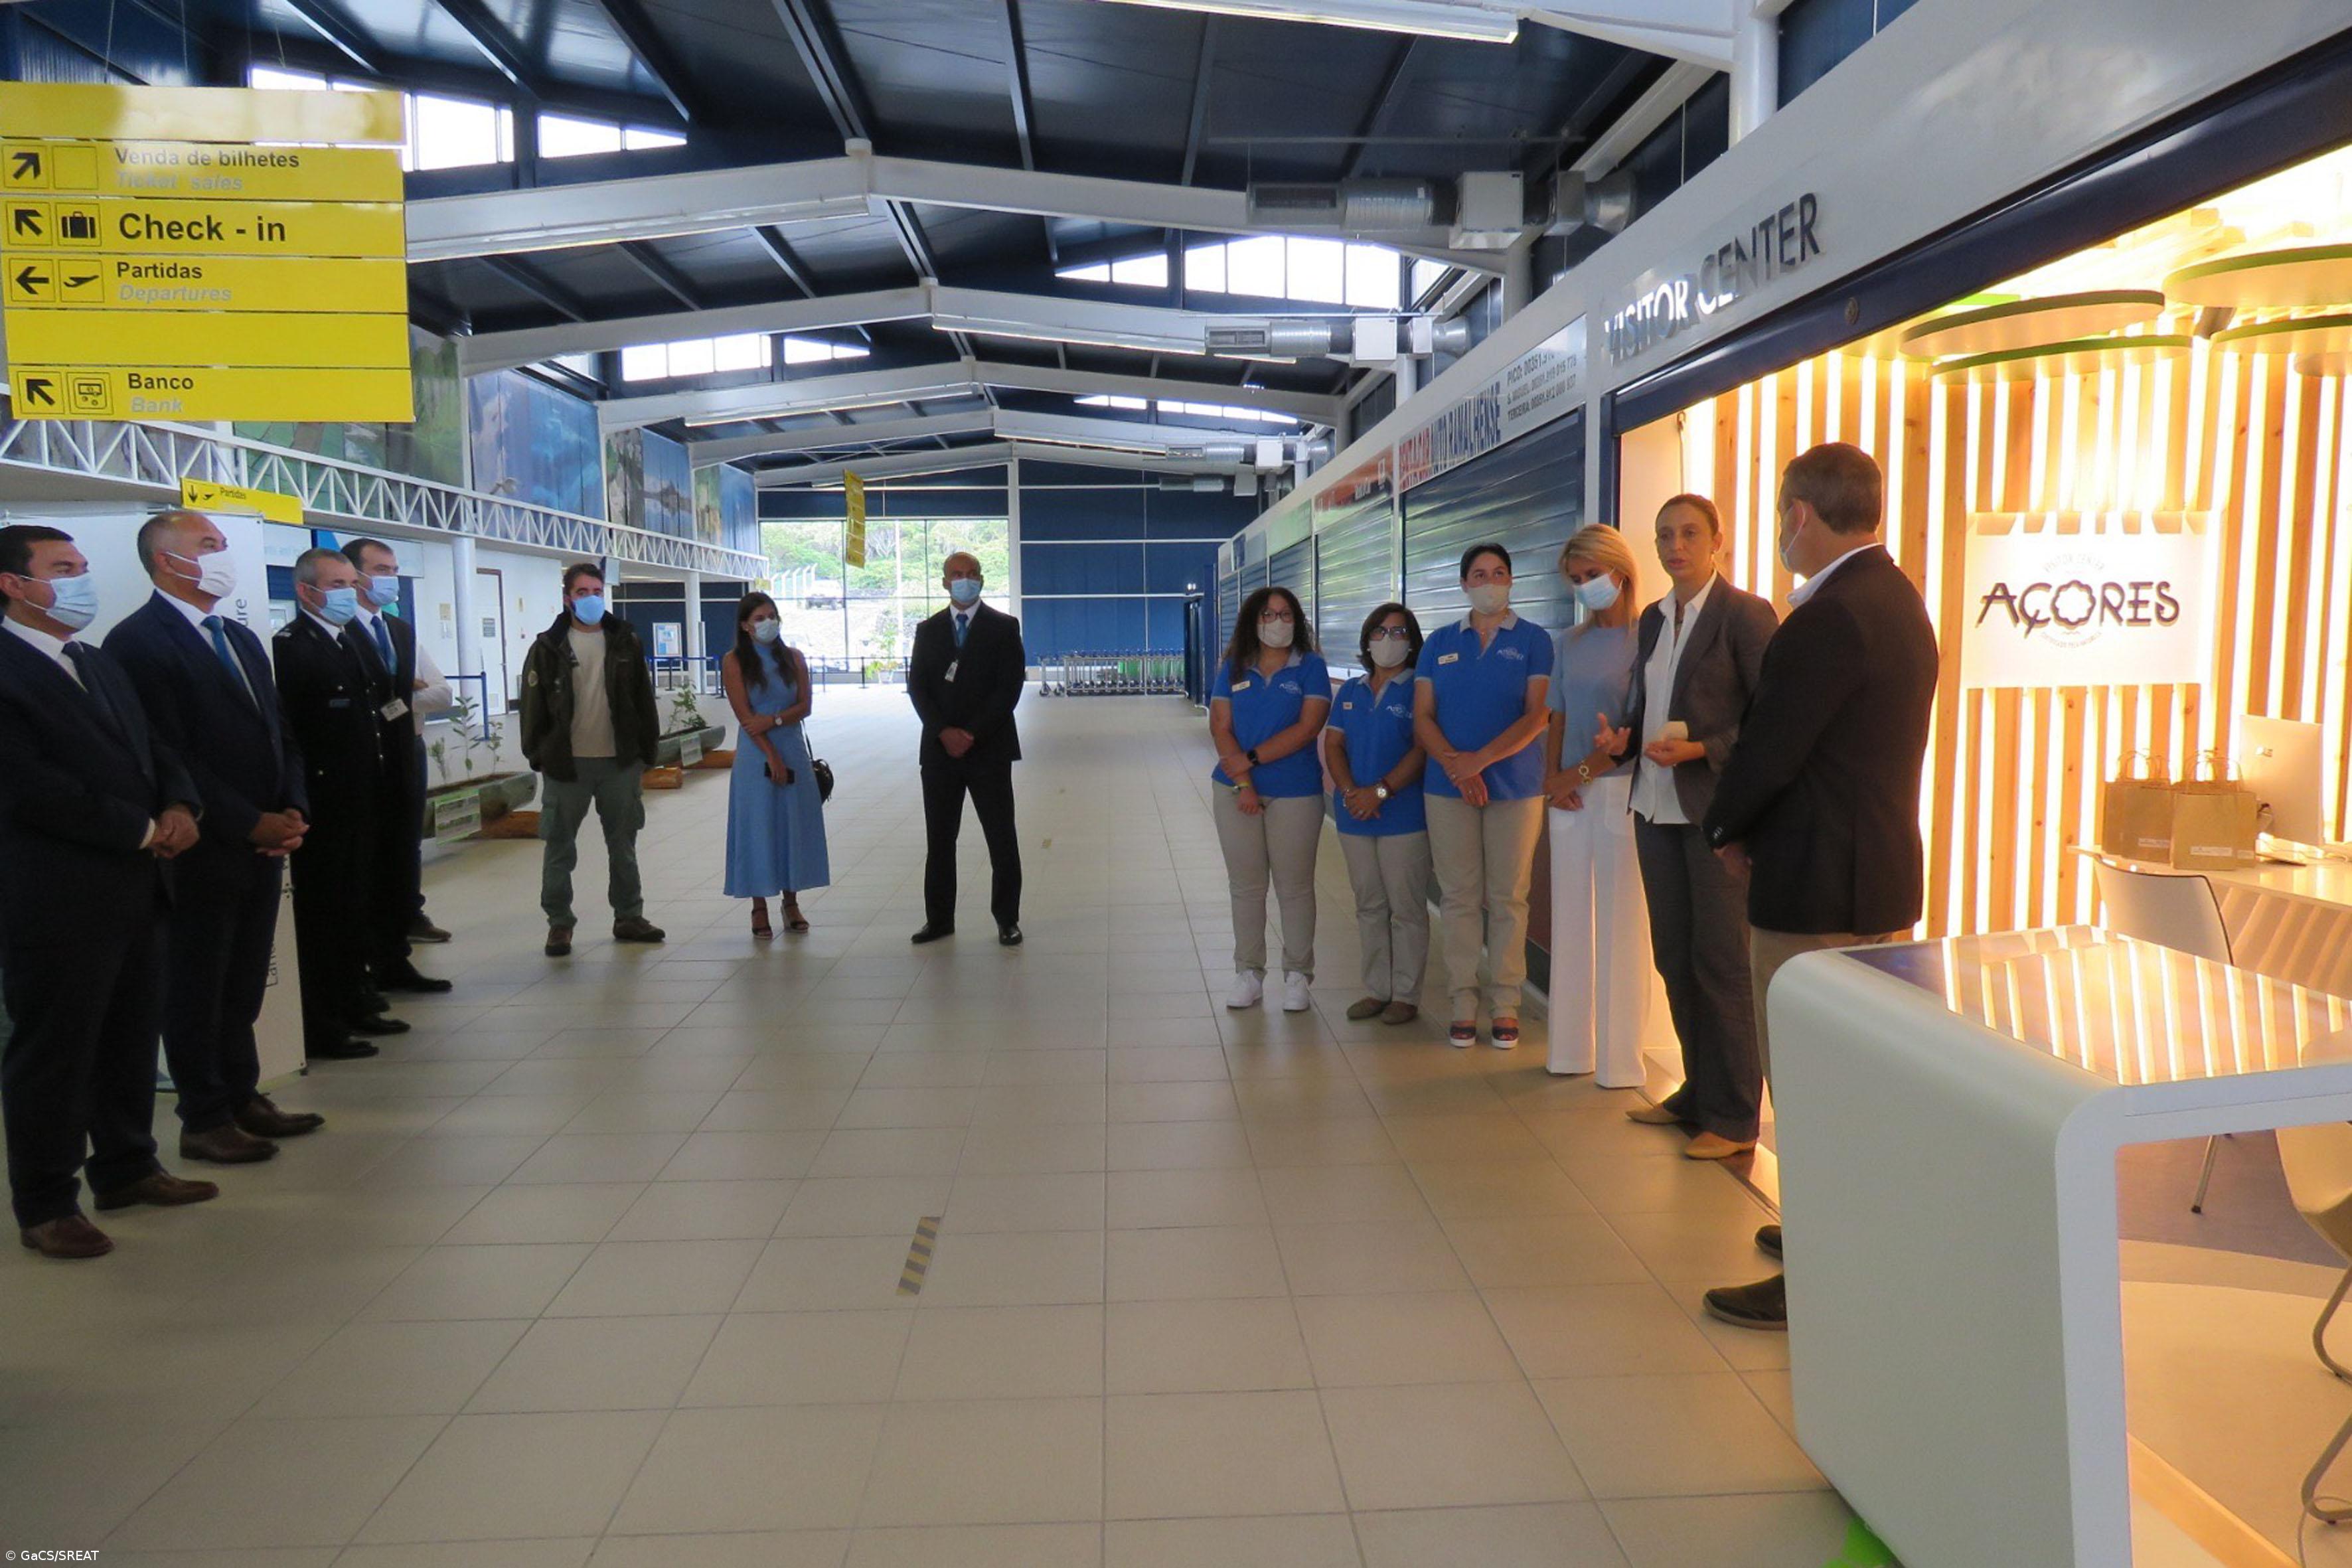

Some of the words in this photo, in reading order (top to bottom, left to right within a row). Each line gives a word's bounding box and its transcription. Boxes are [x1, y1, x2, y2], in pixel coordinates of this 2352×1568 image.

[114, 147, 179, 165] Venda
[187, 150, 212, 166] de
[219, 150, 299, 167] bilhetes
[118, 171, 177, 189] Ticket
[191, 173, 243, 191] sales
[119, 212, 224, 241] Check
[257, 216, 286, 242] in
[117, 261, 202, 279] Partidas
[1604, 279, 1691, 366] VISITOR
[1697, 193, 1820, 315] CENTER
[119, 284, 232, 303] Departures
[128, 372, 194, 390] Banco
[131, 396, 183, 412] Bank
[1974, 579, 2181, 639] AÇORES
